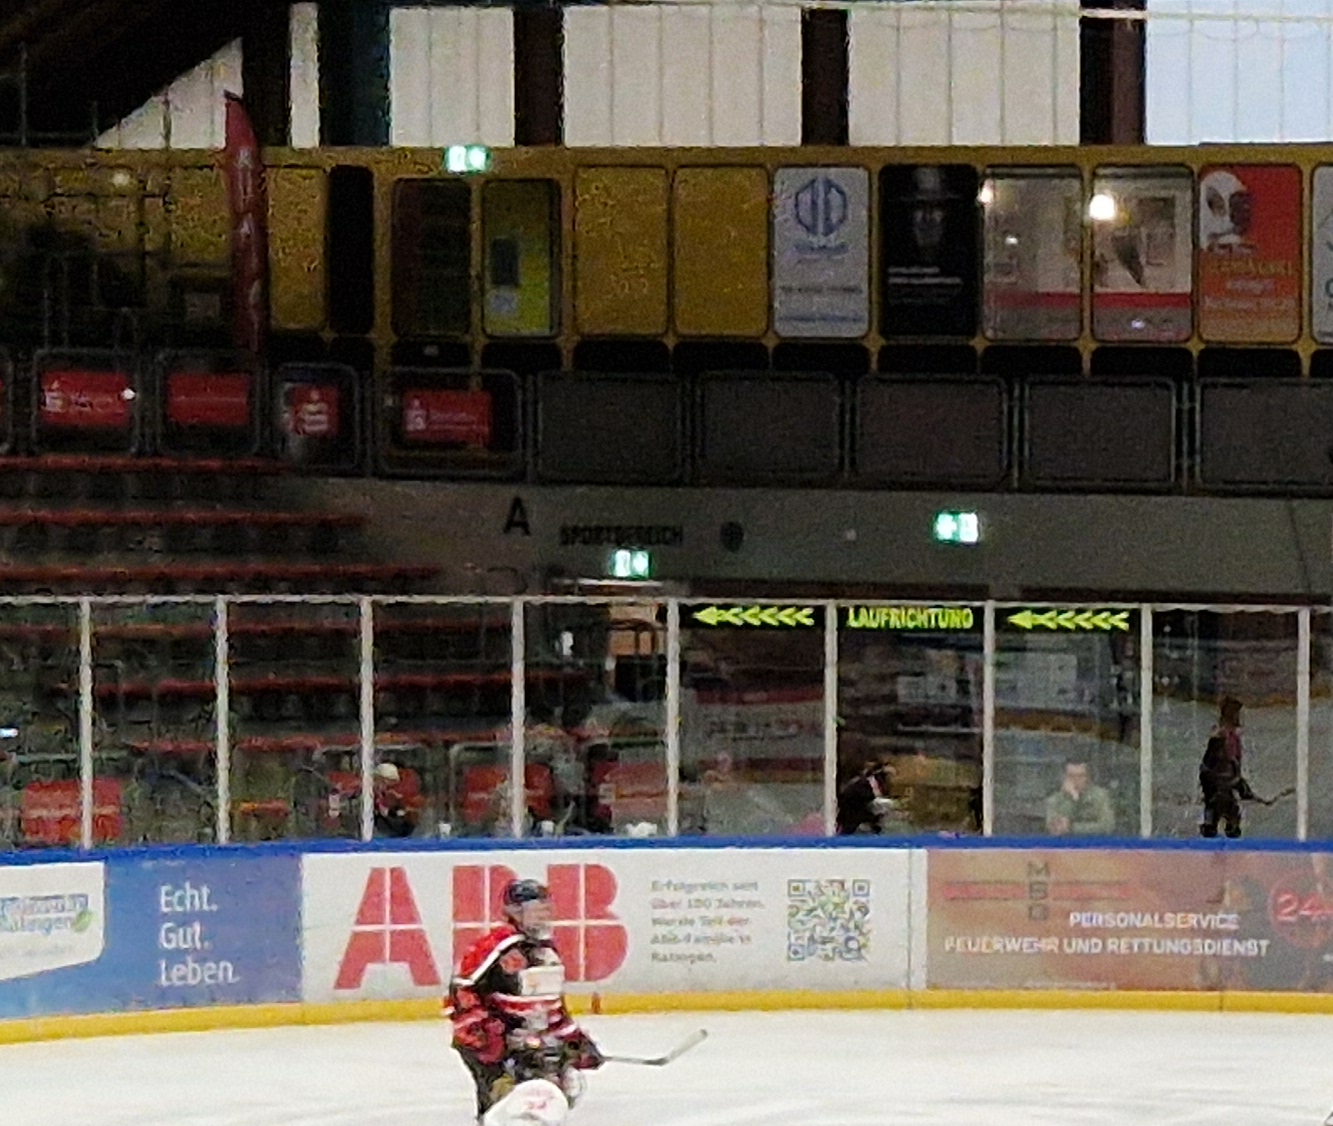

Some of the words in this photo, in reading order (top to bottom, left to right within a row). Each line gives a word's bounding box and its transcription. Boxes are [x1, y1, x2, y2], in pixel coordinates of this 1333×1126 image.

[503, 497, 531, 536] A
[848, 606, 974, 629] LAUFRICHTUNG
[160, 881, 219, 913] Echt.
[1070, 911, 1240, 930] PERSONALSERVICE
[160, 921, 211, 950] Gut.
[945, 936, 1059, 953] FEUERWEHR
[1063, 937, 1102, 954] UND
[1108, 938, 1270, 957] RETTUNGSDIENST
[160, 956, 240, 987] Leben.
